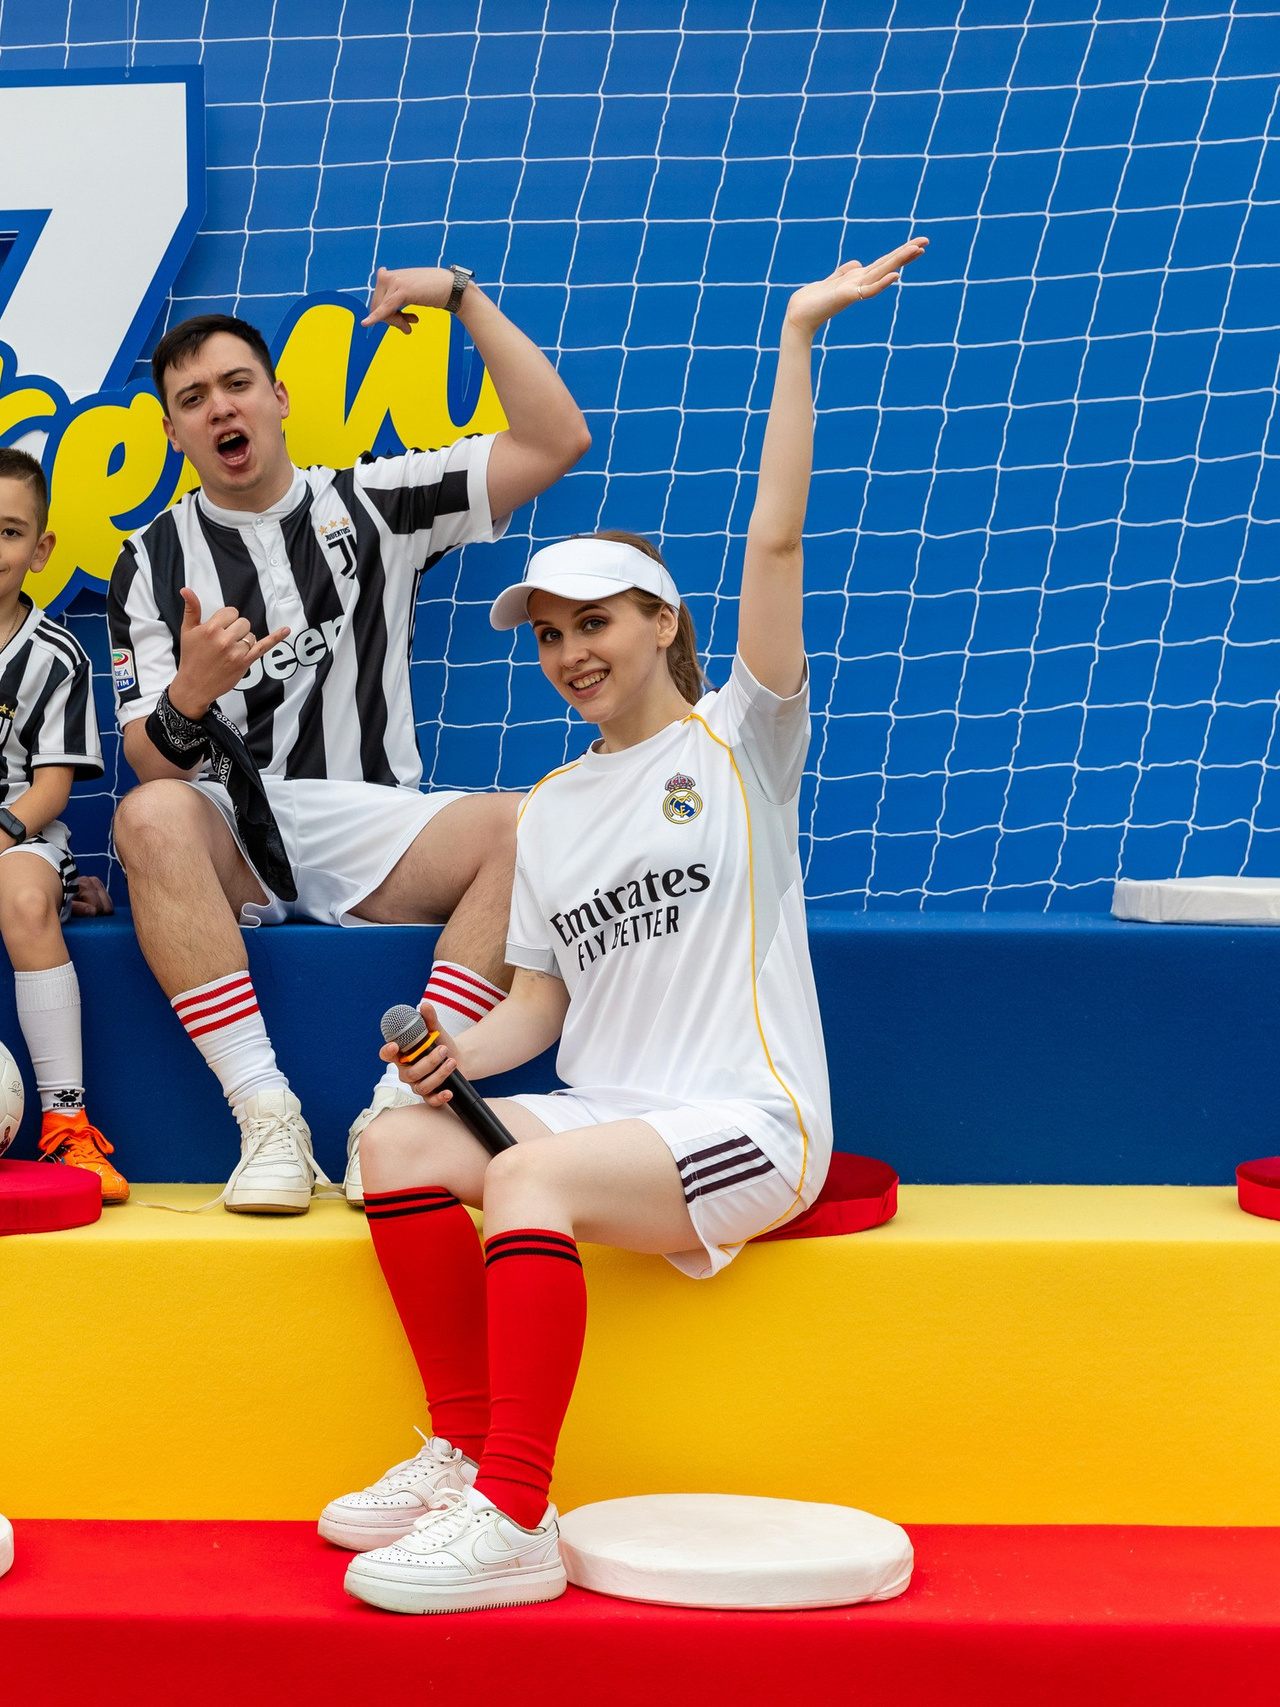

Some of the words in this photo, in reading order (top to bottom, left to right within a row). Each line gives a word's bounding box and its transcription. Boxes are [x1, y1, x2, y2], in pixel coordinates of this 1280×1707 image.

[325, 526, 351, 541] JUVENTUS
[549, 863, 711, 947] Emirates
[577, 930, 607, 971] FLY
[611, 905, 679, 950] BETTER
